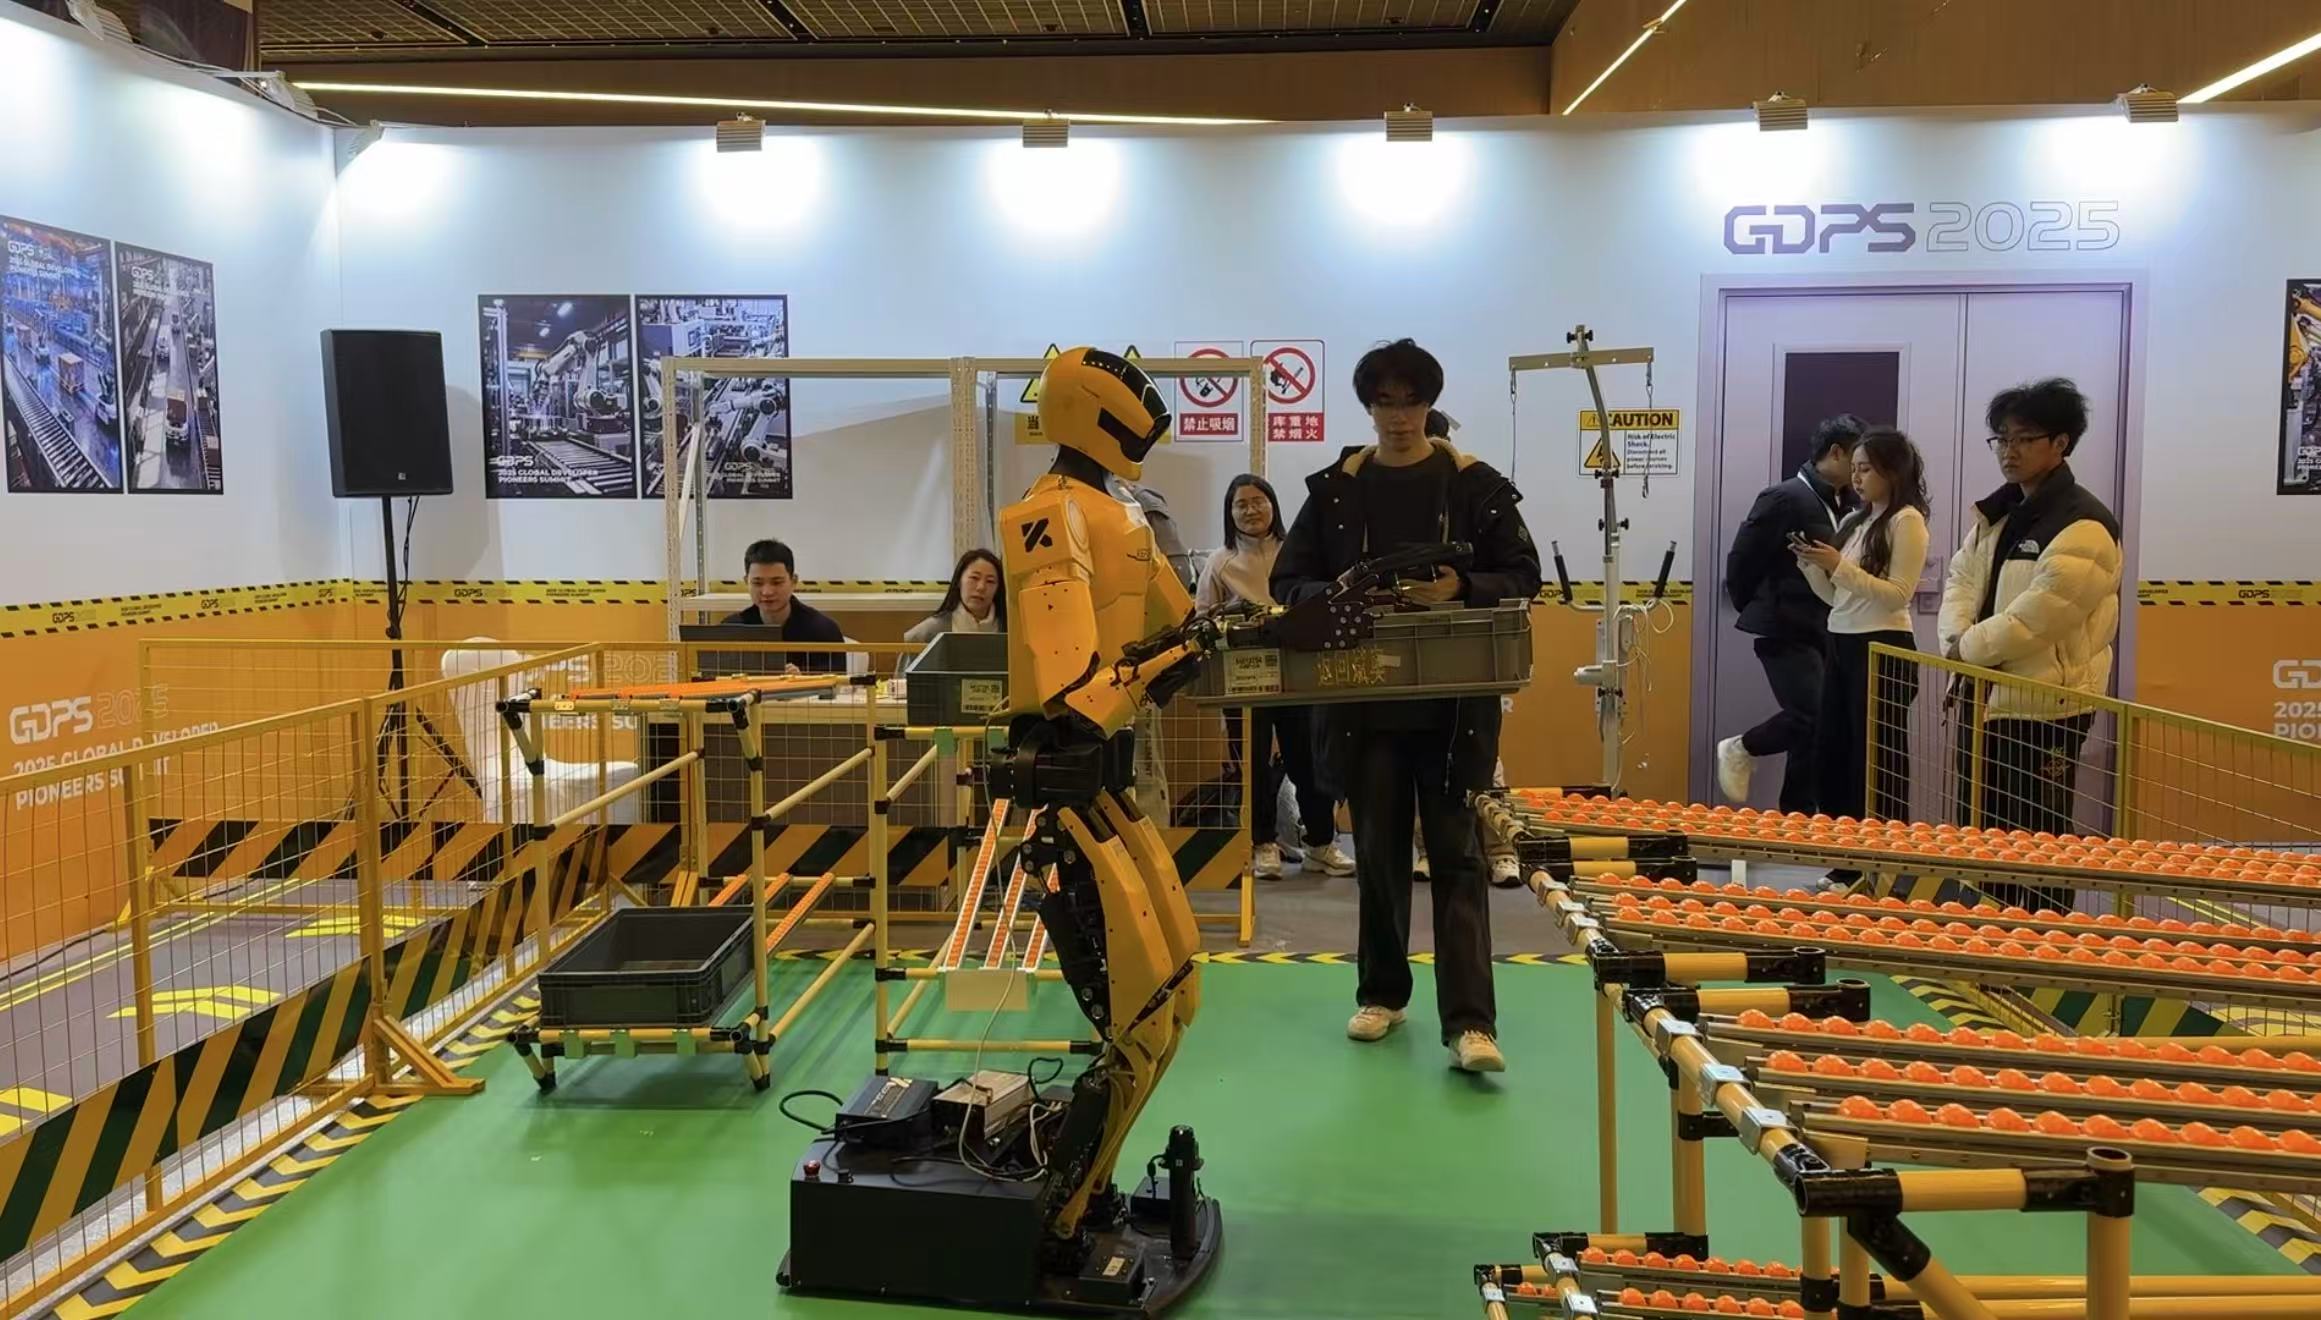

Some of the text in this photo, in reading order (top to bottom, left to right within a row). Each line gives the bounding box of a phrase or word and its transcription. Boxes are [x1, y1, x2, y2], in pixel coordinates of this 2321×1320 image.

[1723, 200, 2120, 254] GDPS 2025
[1183, 417, 1236, 432] 禁止吸烟
[1272, 415, 1319, 427] 库重地
[1607, 412, 1673, 426] AUTION
[1272, 428, 1319, 440] 禁烟火
[2238, 589, 2270, 599] GDPS
[9, 683, 170, 744] GDPS 205
[16, 772, 105, 810] PIONEERS
